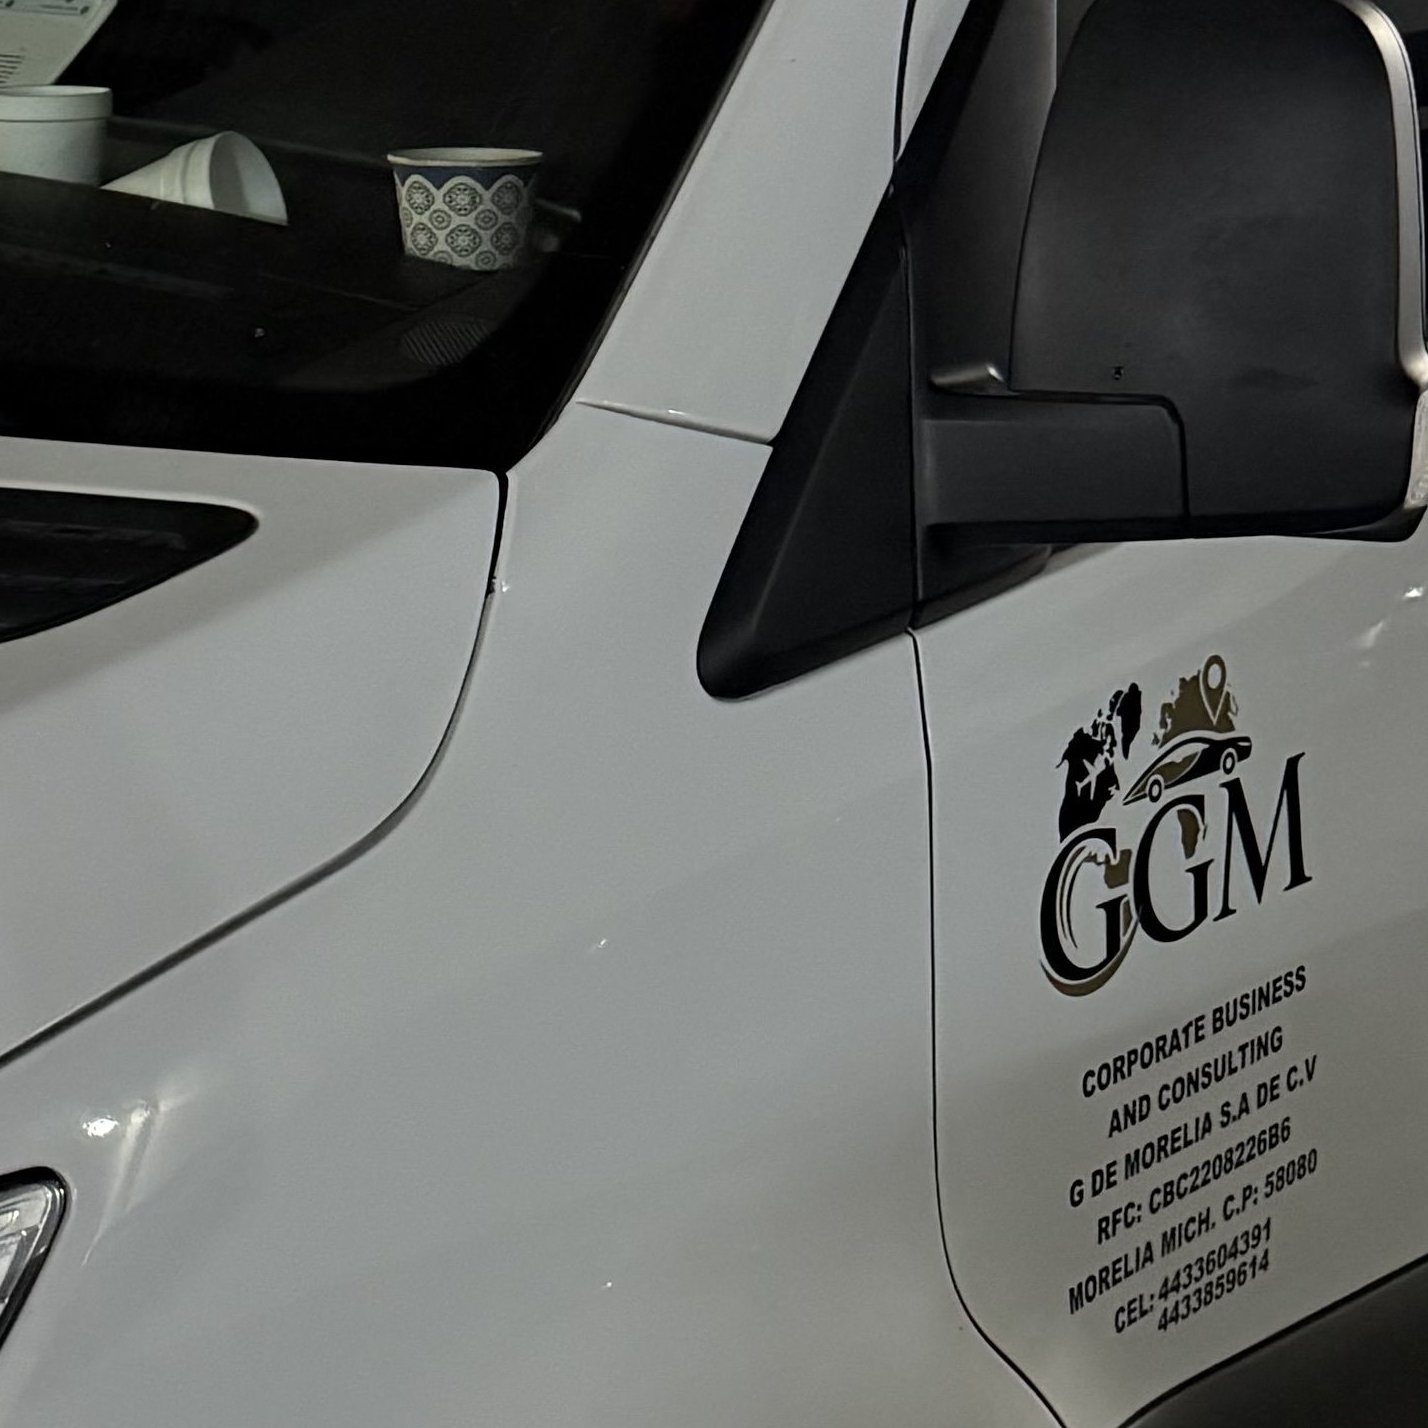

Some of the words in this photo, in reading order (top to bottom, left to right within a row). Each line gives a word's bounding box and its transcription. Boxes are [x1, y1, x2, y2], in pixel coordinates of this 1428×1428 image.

[1039, 751, 1312, 984] GGM
[1082, 1014, 1206, 1098] CORPORATE
[1212, 965, 1307, 1035] BUSINESS
[1107, 1094, 1151, 1139] AND
[1158, 1025, 1283, 1111] CONSULTING
[1069, 1179, 1084, 1208] G
[1091, 1160, 1118, 1198] DE
[1124, 1112, 1212, 1181] MORELIA
[1220, 1092, 1251, 1129] S.A
[1257, 1074, 1281, 1110] DE
[1286, 1054, 1317, 1092] C.V
[1097, 1201, 1142, 1245] RFC:
[1149, 1116, 1291, 1215] CBC2208226B6
[1068, 1241, 1154, 1315] MORELIA
[1161, 1207, 1216, 1258] MICH.
[1223, 1184, 1259, 1222] C.P:
[1264, 1148, 1318, 1199] 58080
[1114, 1293, 1155, 1334] CEL:
[1158, 1217, 1271, 1302] 4433604391
[1157, 1248, 1270, 1332] 4433859614
